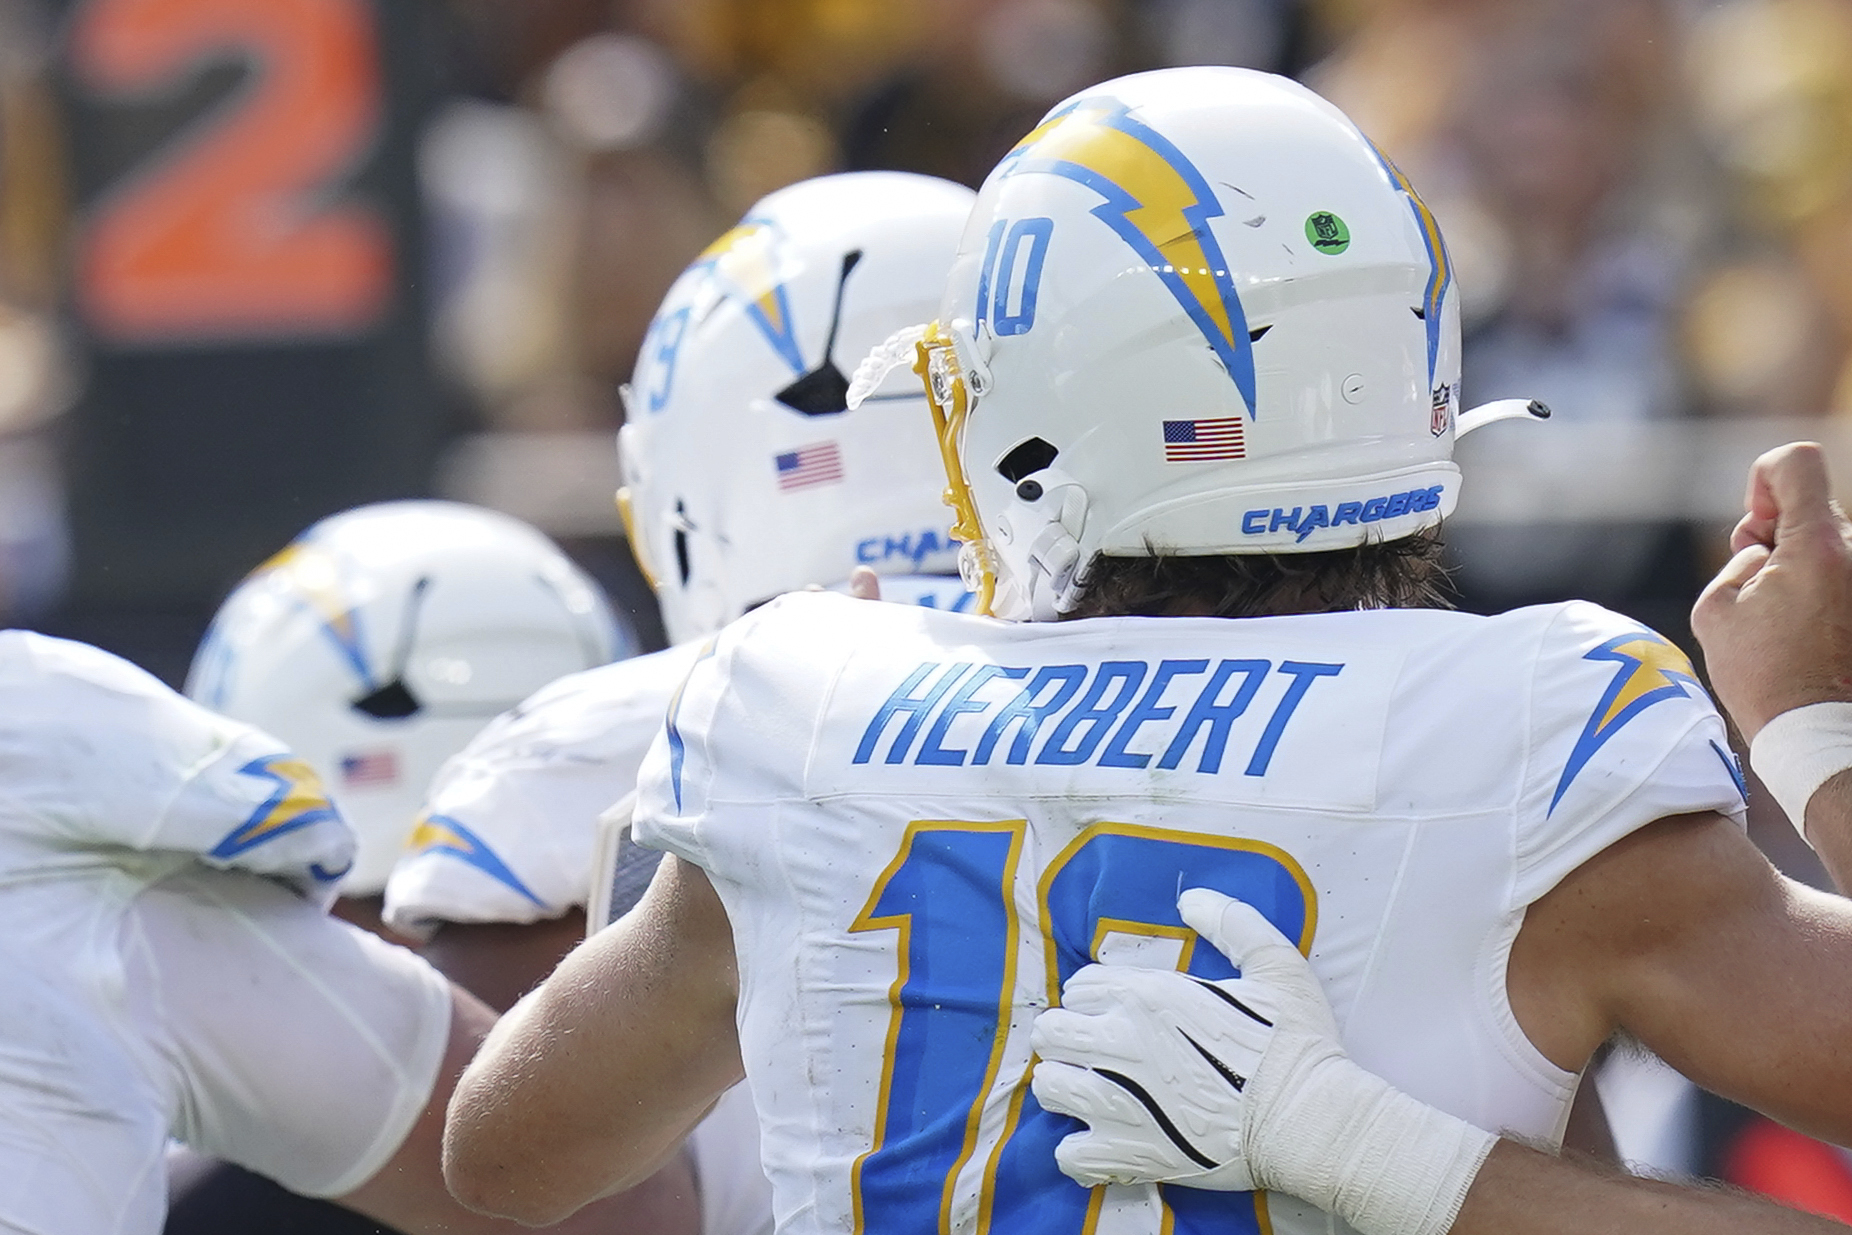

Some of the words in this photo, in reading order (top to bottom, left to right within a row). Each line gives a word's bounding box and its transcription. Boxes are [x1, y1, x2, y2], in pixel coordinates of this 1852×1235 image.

[974, 217, 1054, 340] 10
[1241, 485, 1444, 543] CHARGERS
[851, 658, 1346, 777] HERBERT
